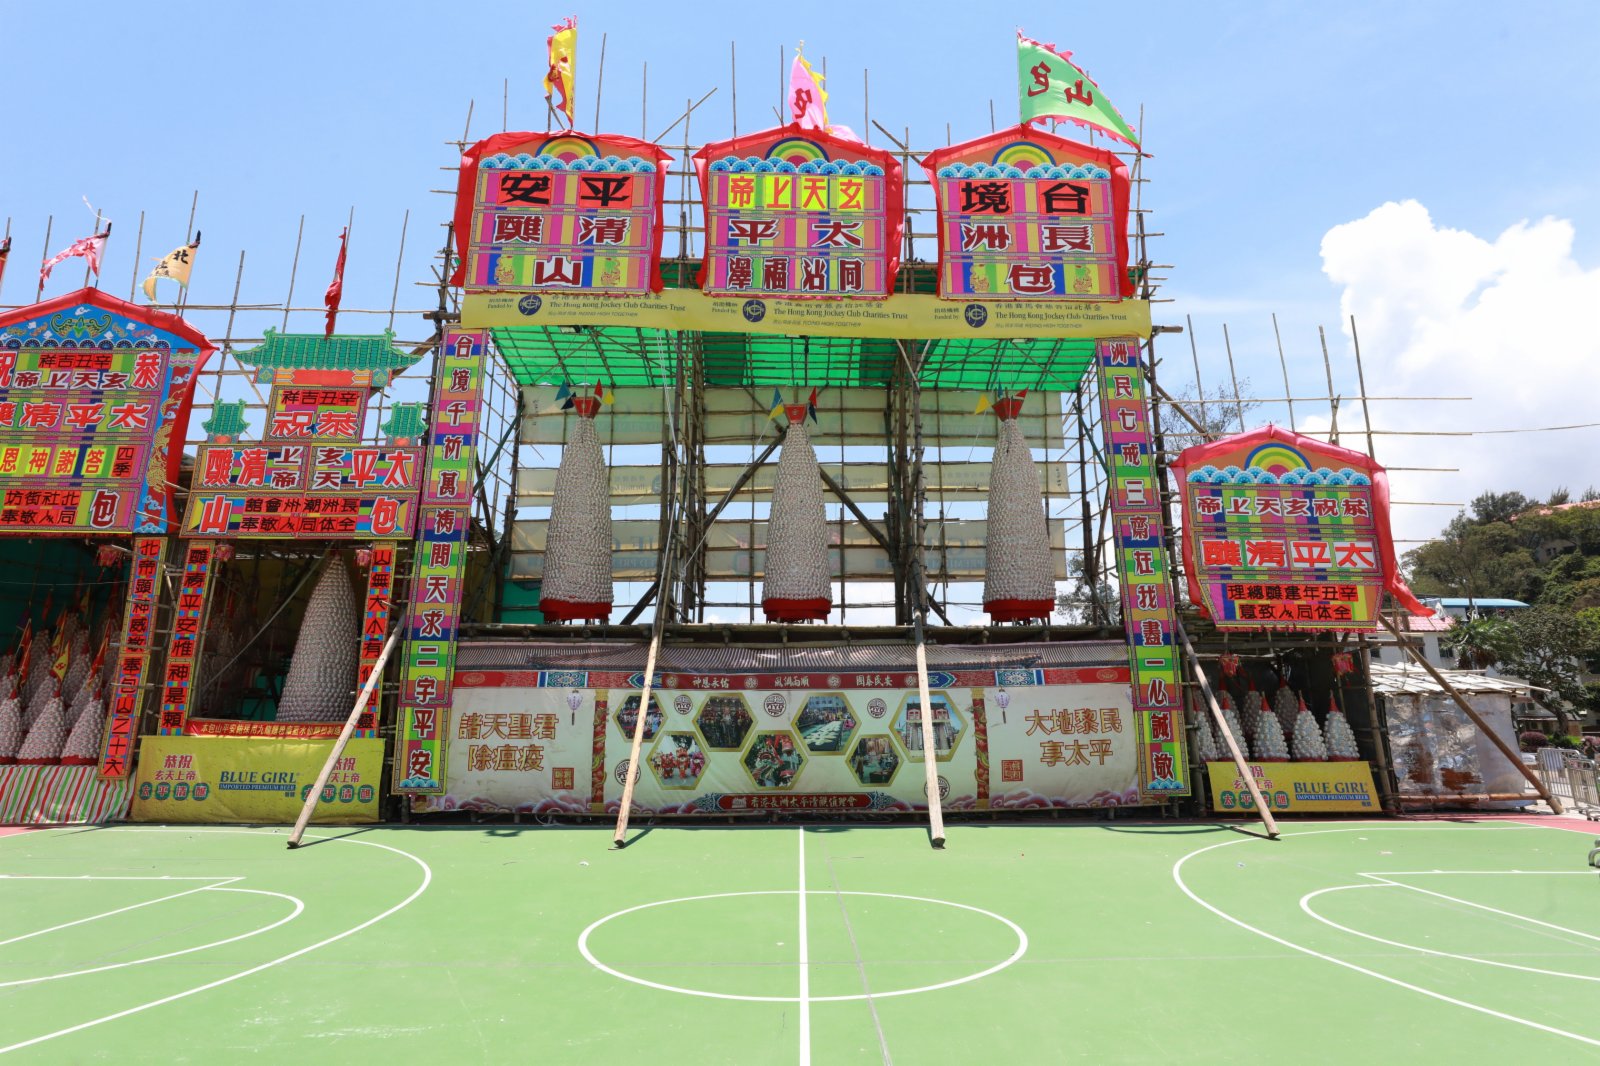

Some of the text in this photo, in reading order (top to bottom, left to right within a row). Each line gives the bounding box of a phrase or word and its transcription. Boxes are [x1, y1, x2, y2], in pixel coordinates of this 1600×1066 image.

[534, 255, 582, 286] 山
[1007, 263, 1055, 295] 包
[600, 302, 621, 310] Jockey
[788, 309, 805, 317] Hong
[806, 310, 823, 318] Kong
[824, 310, 845, 318] Jockey
[863, 311, 890, 319] Charities
[1009, 312, 1026, 320] Hong
[1027, 312, 1044, 320] Kong
[1045, 313, 1065, 321] Jockey
[90, 489, 119, 528] 包
[199, 495, 232, 534] 山
[370, 496, 399, 535] 包
[458, 712, 559, 740] 諸天聖君
[1025, 708, 1122, 736] 大地黎民
[468, 744, 544, 771] 除瘟疫
[1040, 739, 1113, 767] 享太平
[164, 755, 193, 769] 恭祝
[155, 770, 196, 781] 玄天上帝
[220, 771, 296, 784] BLUE GIRL
[331, 772, 360, 783] 天上帝
[1238, 766, 1264, 778] 祝
[1234, 779, 1273, 790] 玄上帝
[1294, 782, 1368, 794] BLUE GIRL
